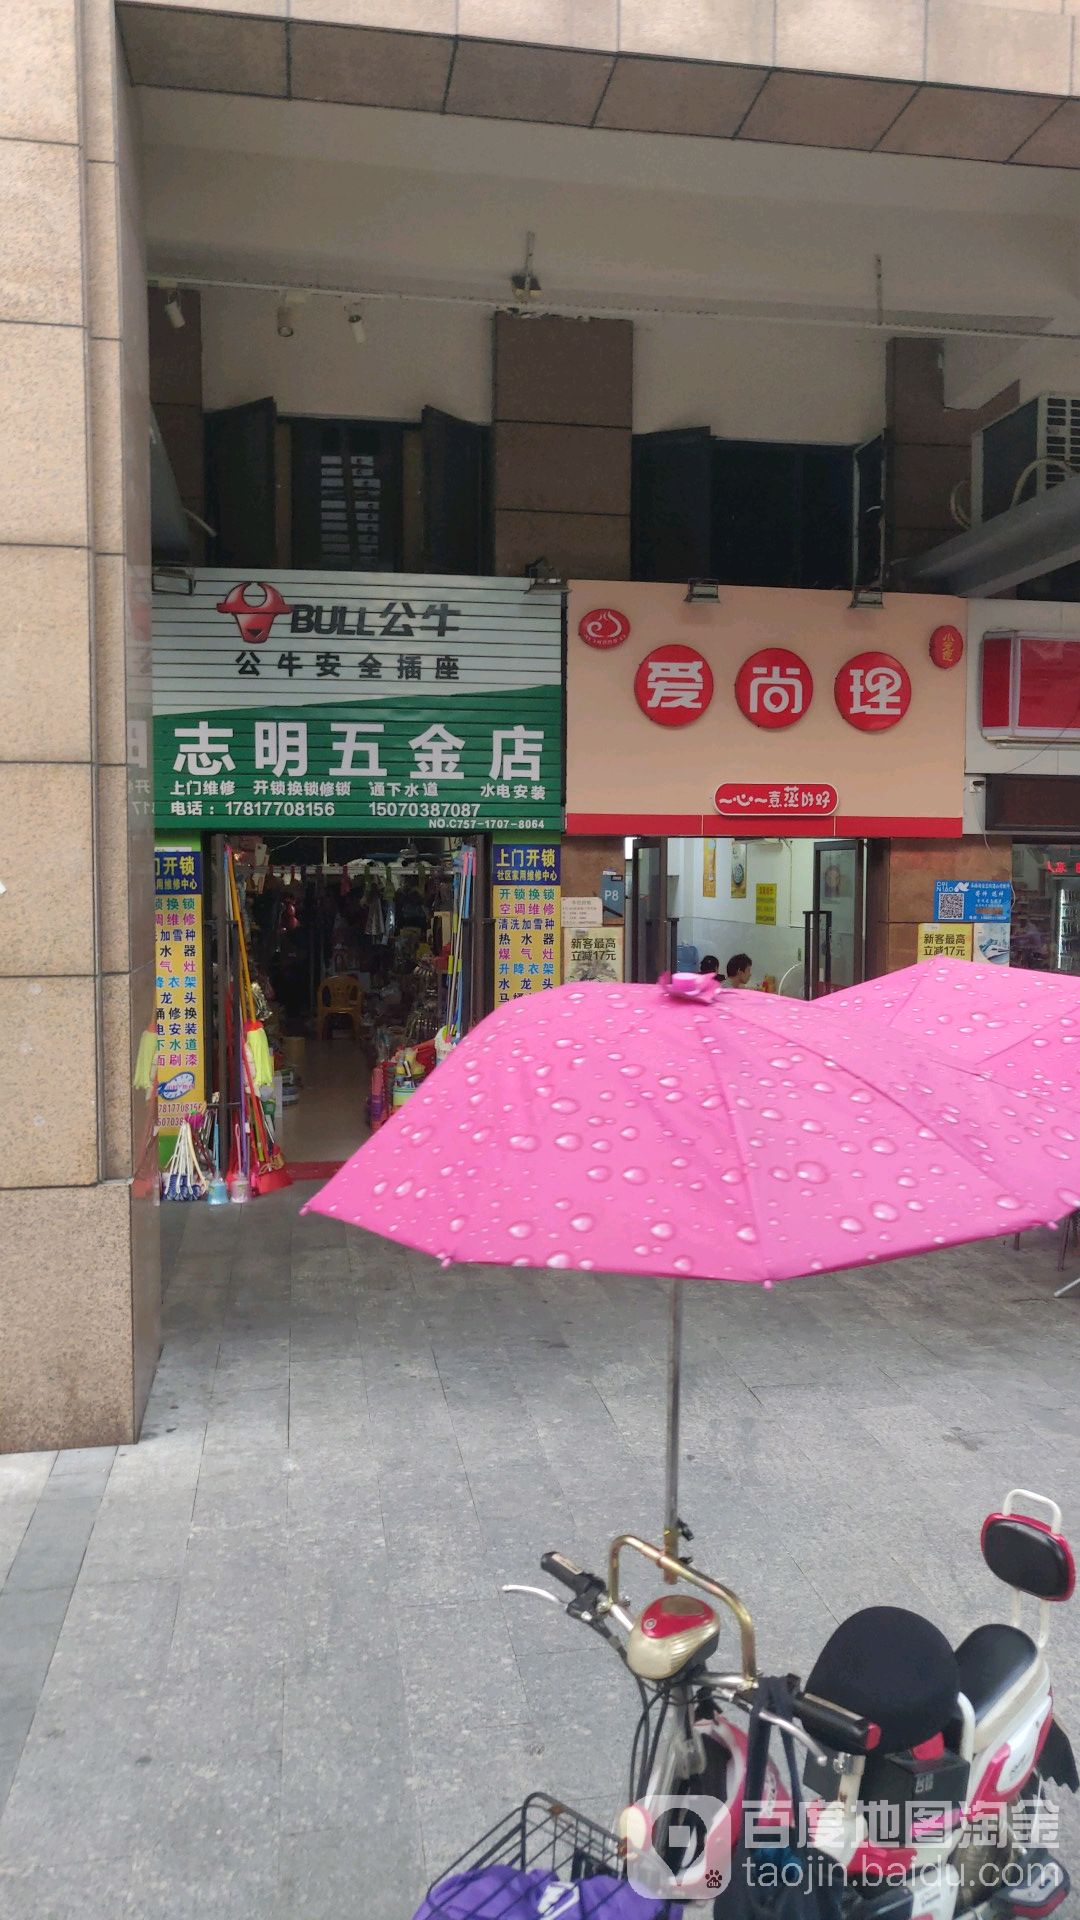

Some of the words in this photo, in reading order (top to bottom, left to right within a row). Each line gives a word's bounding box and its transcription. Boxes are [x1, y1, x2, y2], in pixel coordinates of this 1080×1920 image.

[235, 651, 460, 680] 公牛安全插座
[173, 721, 545, 782] 志明五金店
[170, 780, 236, 796] 上门维修
[253, 780, 352, 797] 开锁换锁修锁
[368, 781, 439, 798] 通下水道
[480, 783, 546, 800] 水电安装
[225, 802, 335, 816] 17817708156
[368, 802, 480, 817] 15070387087
[496, 848, 556, 867] 上门开锁
[497, 870, 557, 881] 社区家用维修中心
[499, 888, 555, 901] 开锁换锁
[604, 889, 619, 902] P8
[499, 903, 555, 915] 空调维修
[498, 918, 555, 930] 清洗加雪种
[498, 933, 555, 945] 热水器
[571, 937, 616, 949] 新客最高
[923, 934, 966, 945] 新客最高
[498, 948, 554, 960] 煤气灶
[571, 949, 616, 962] 立减17元
[923, 946, 966, 956] 立减17元
[498, 963, 554, 975] 升降衣架
[498, 978, 554, 990] 水龙头
